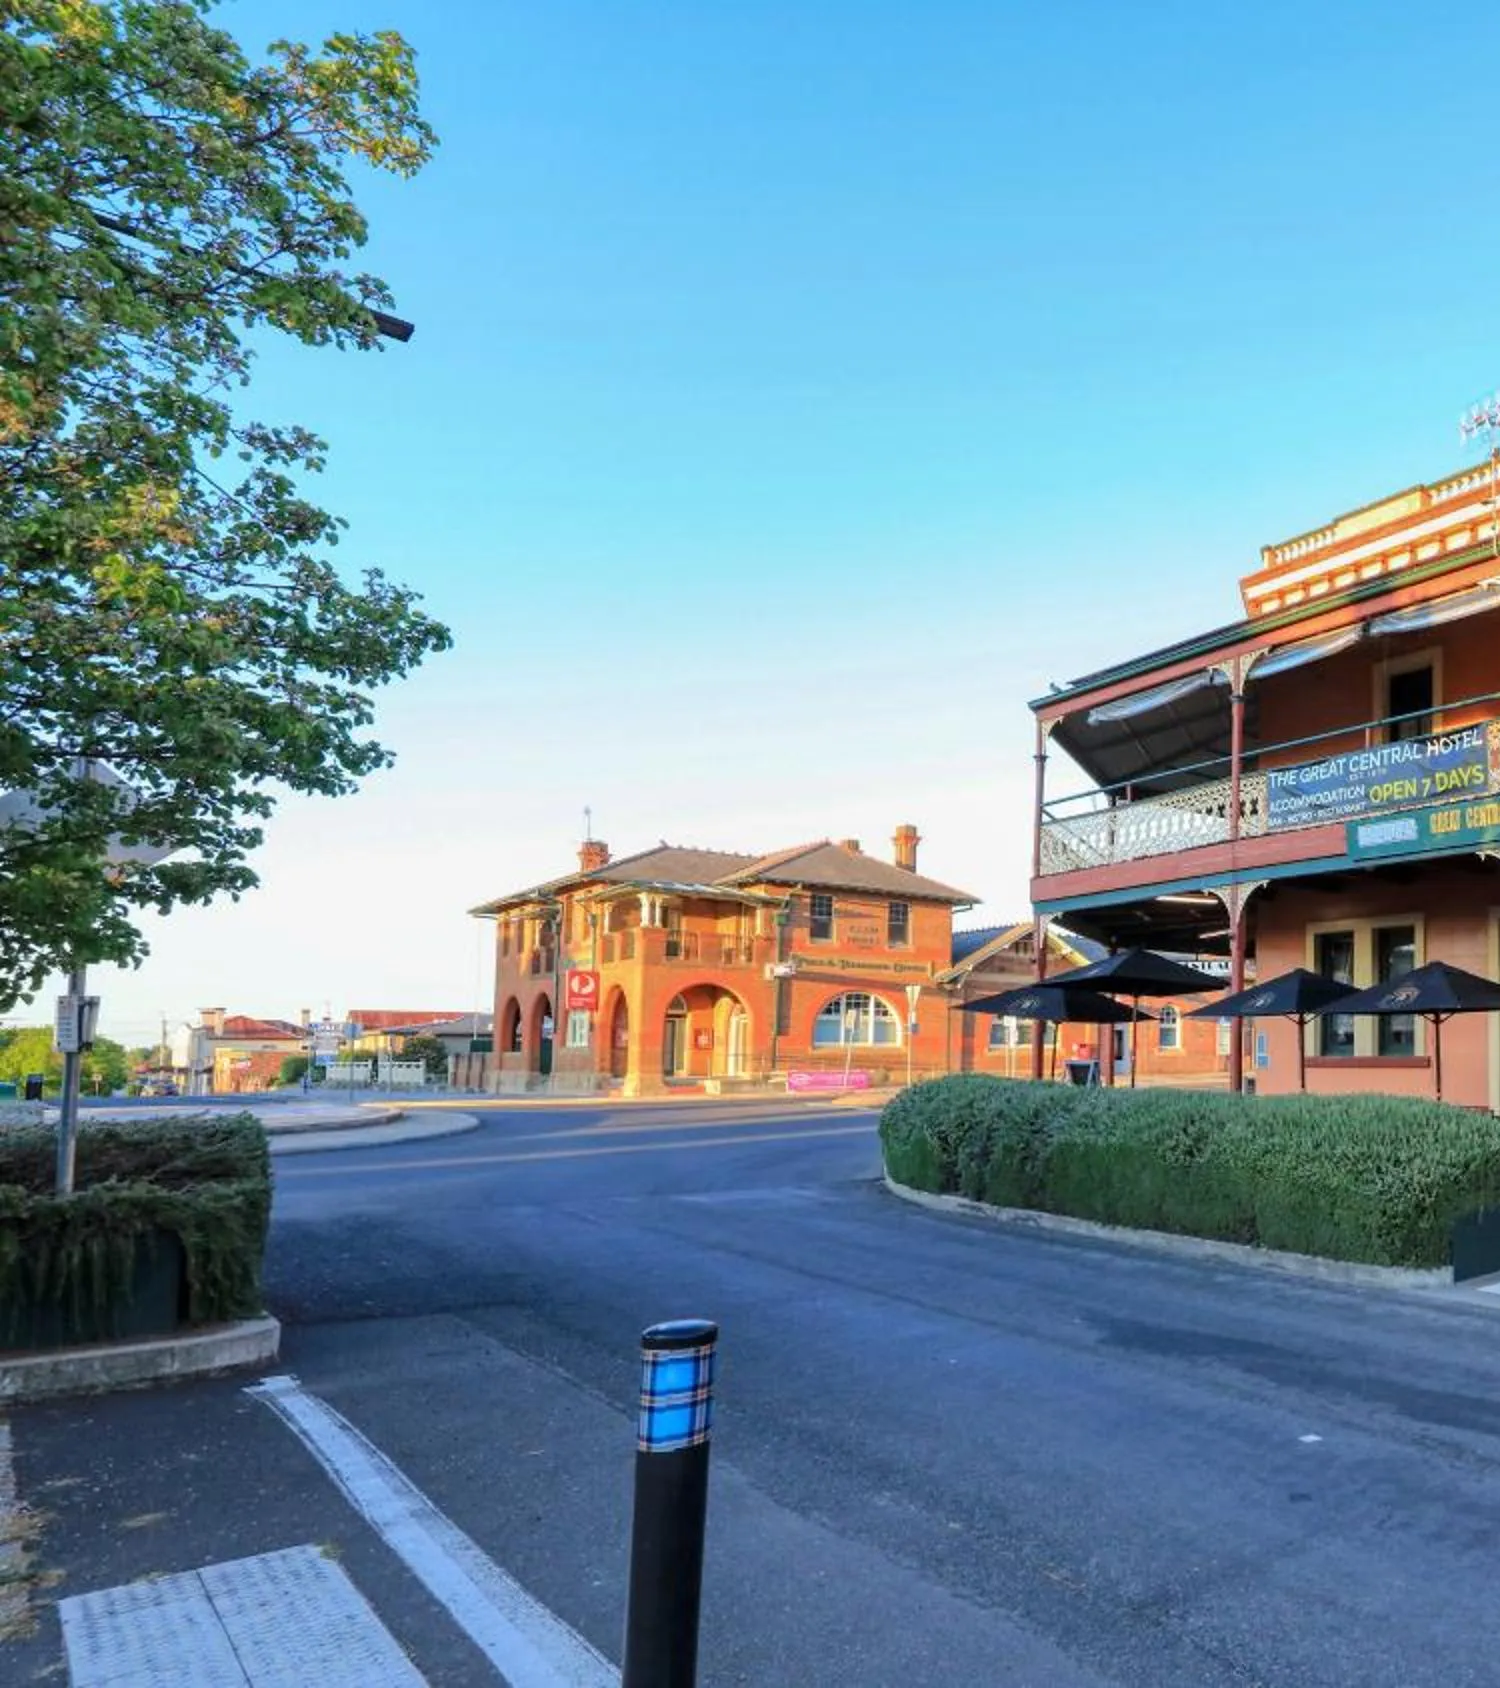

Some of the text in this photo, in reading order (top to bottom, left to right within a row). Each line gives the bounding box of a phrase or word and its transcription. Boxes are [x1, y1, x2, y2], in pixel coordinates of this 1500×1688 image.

[1269, 727, 1484, 788] THE GREAT CENTRAL HOTEL
[1270, 783, 1365, 813] ACCOMMODATION
[1369, 764, 1485, 803] OPEN 7 DAYS
[1430, 809, 1461, 834] GREAT
